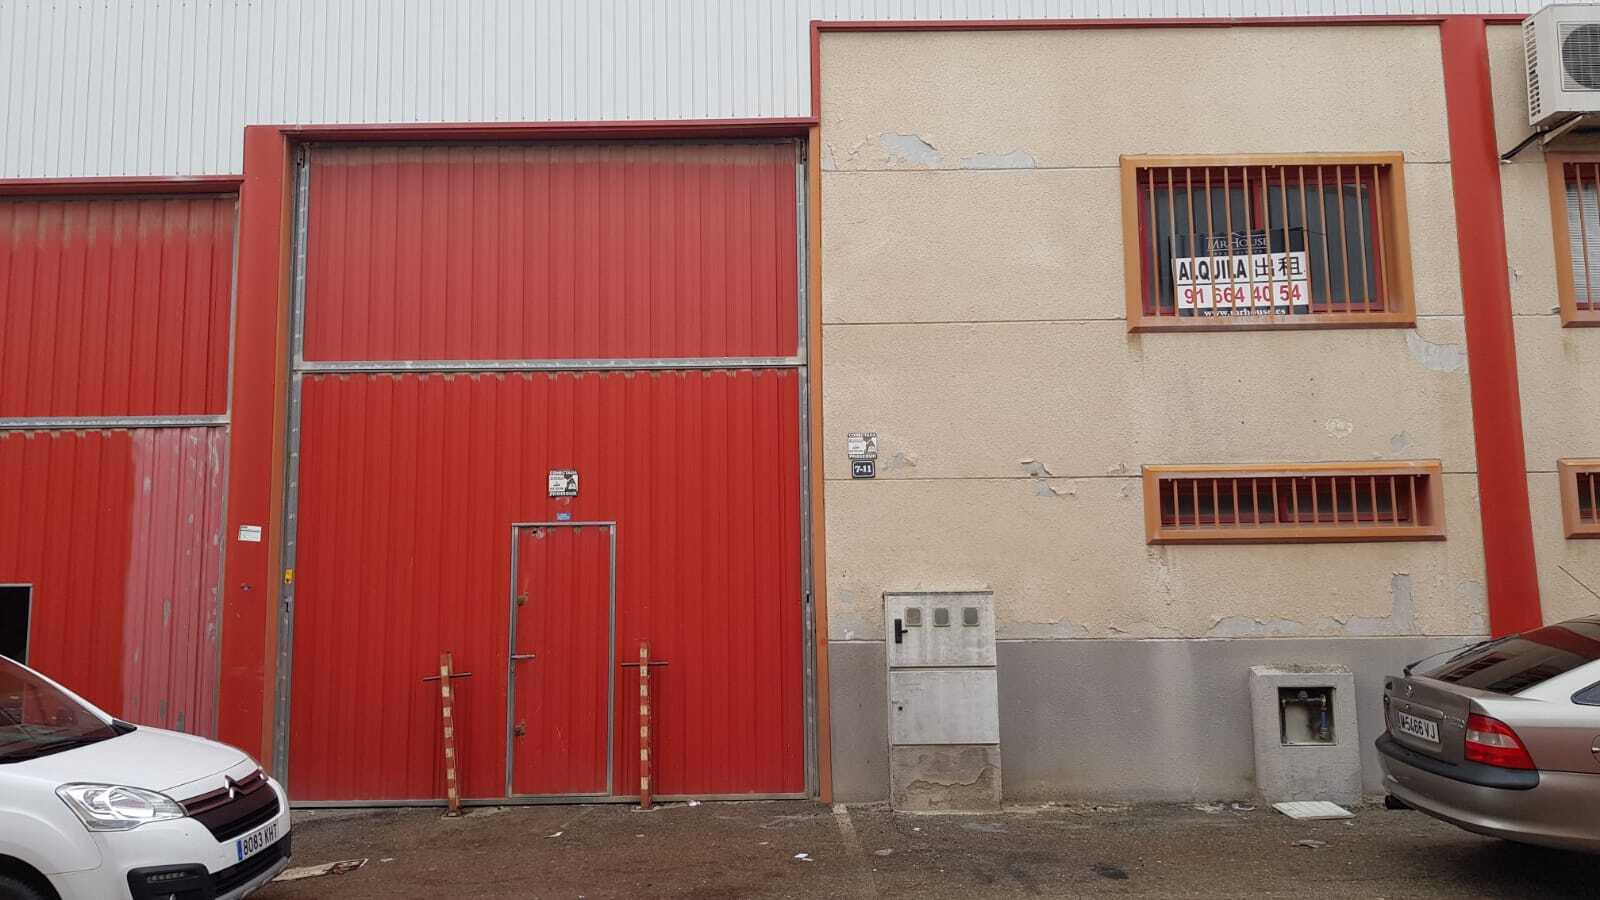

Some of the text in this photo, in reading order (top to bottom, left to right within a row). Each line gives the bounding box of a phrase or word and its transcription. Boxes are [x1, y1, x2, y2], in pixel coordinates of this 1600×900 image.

[1178, 258, 1247, 281] ALQUILA
[1255, 256, 1303, 278] 出租
[1184, 284, 1301, 304] 91 664 40 54
[854, 464, 871, 473] 7-11
[243, 823, 278, 855] 8083 KHT
